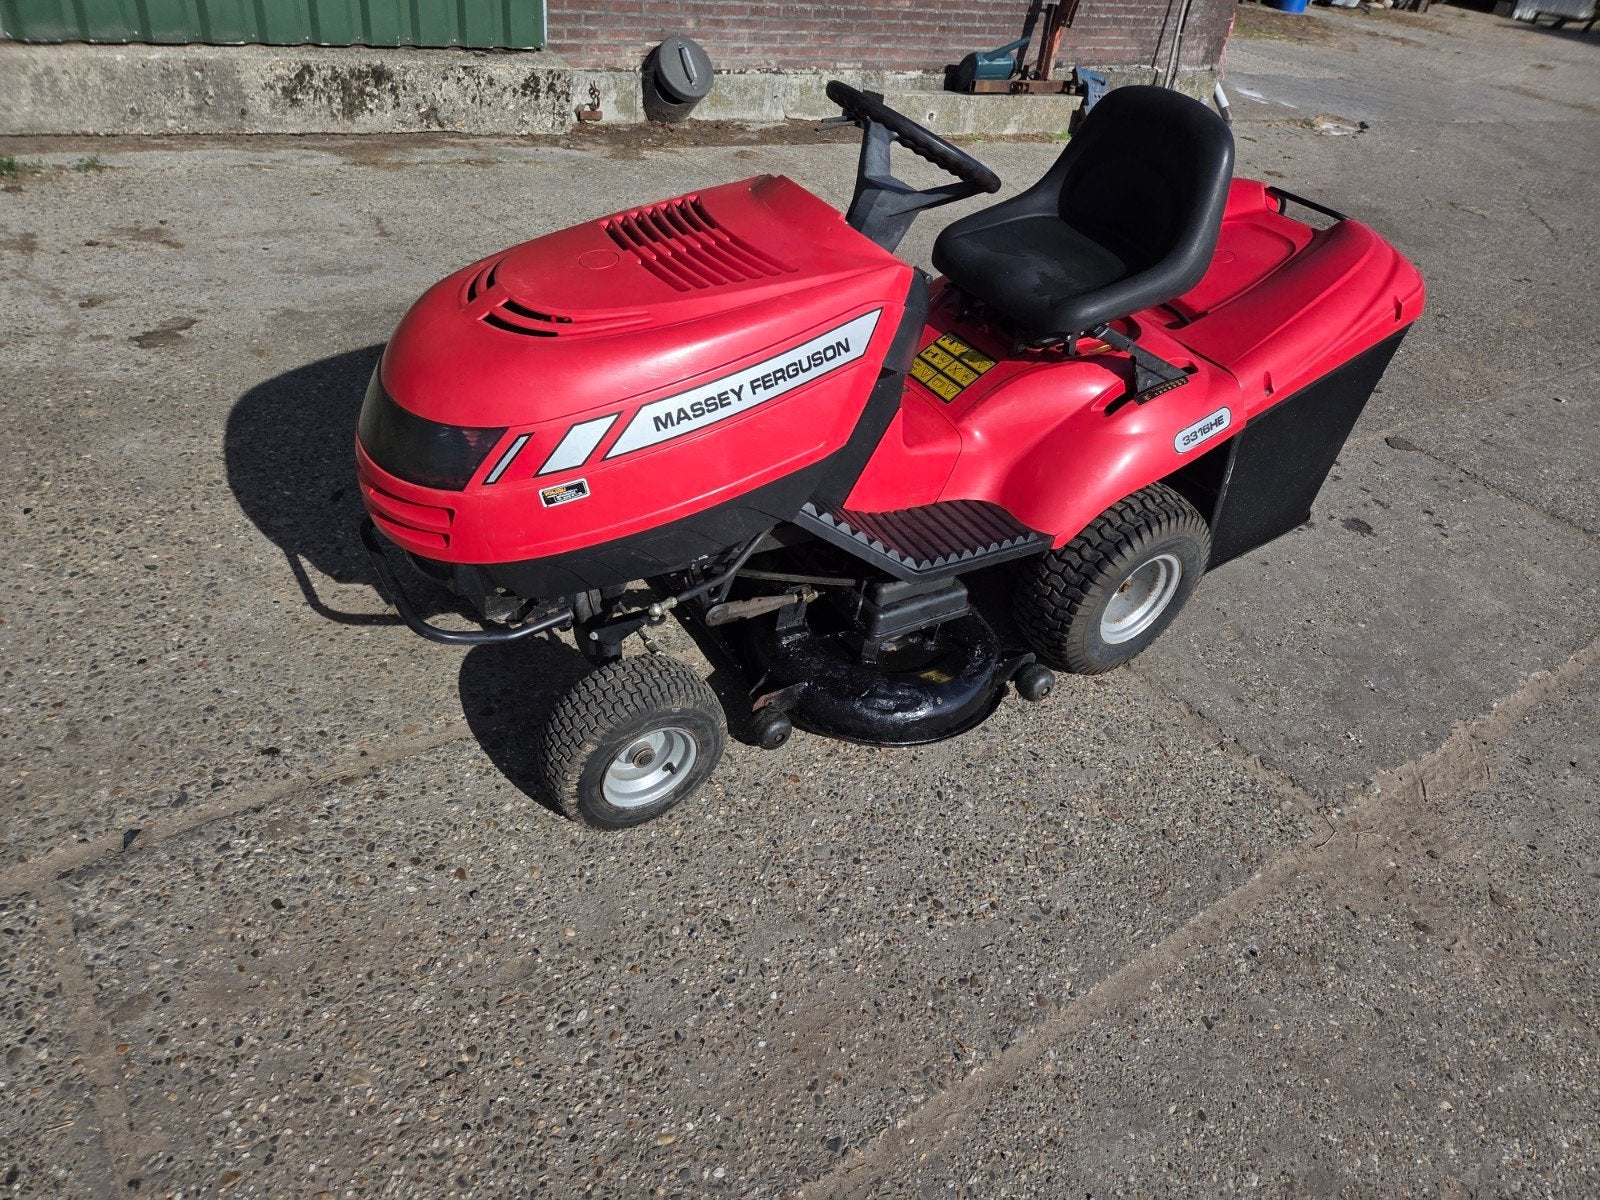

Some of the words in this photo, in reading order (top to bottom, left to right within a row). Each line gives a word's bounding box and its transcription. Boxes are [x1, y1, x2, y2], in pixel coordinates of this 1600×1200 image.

[653, 384, 744, 432] MASSEY
[750, 337, 850, 395] FERGUSON
[1182, 415, 1225, 446] 3316HE
